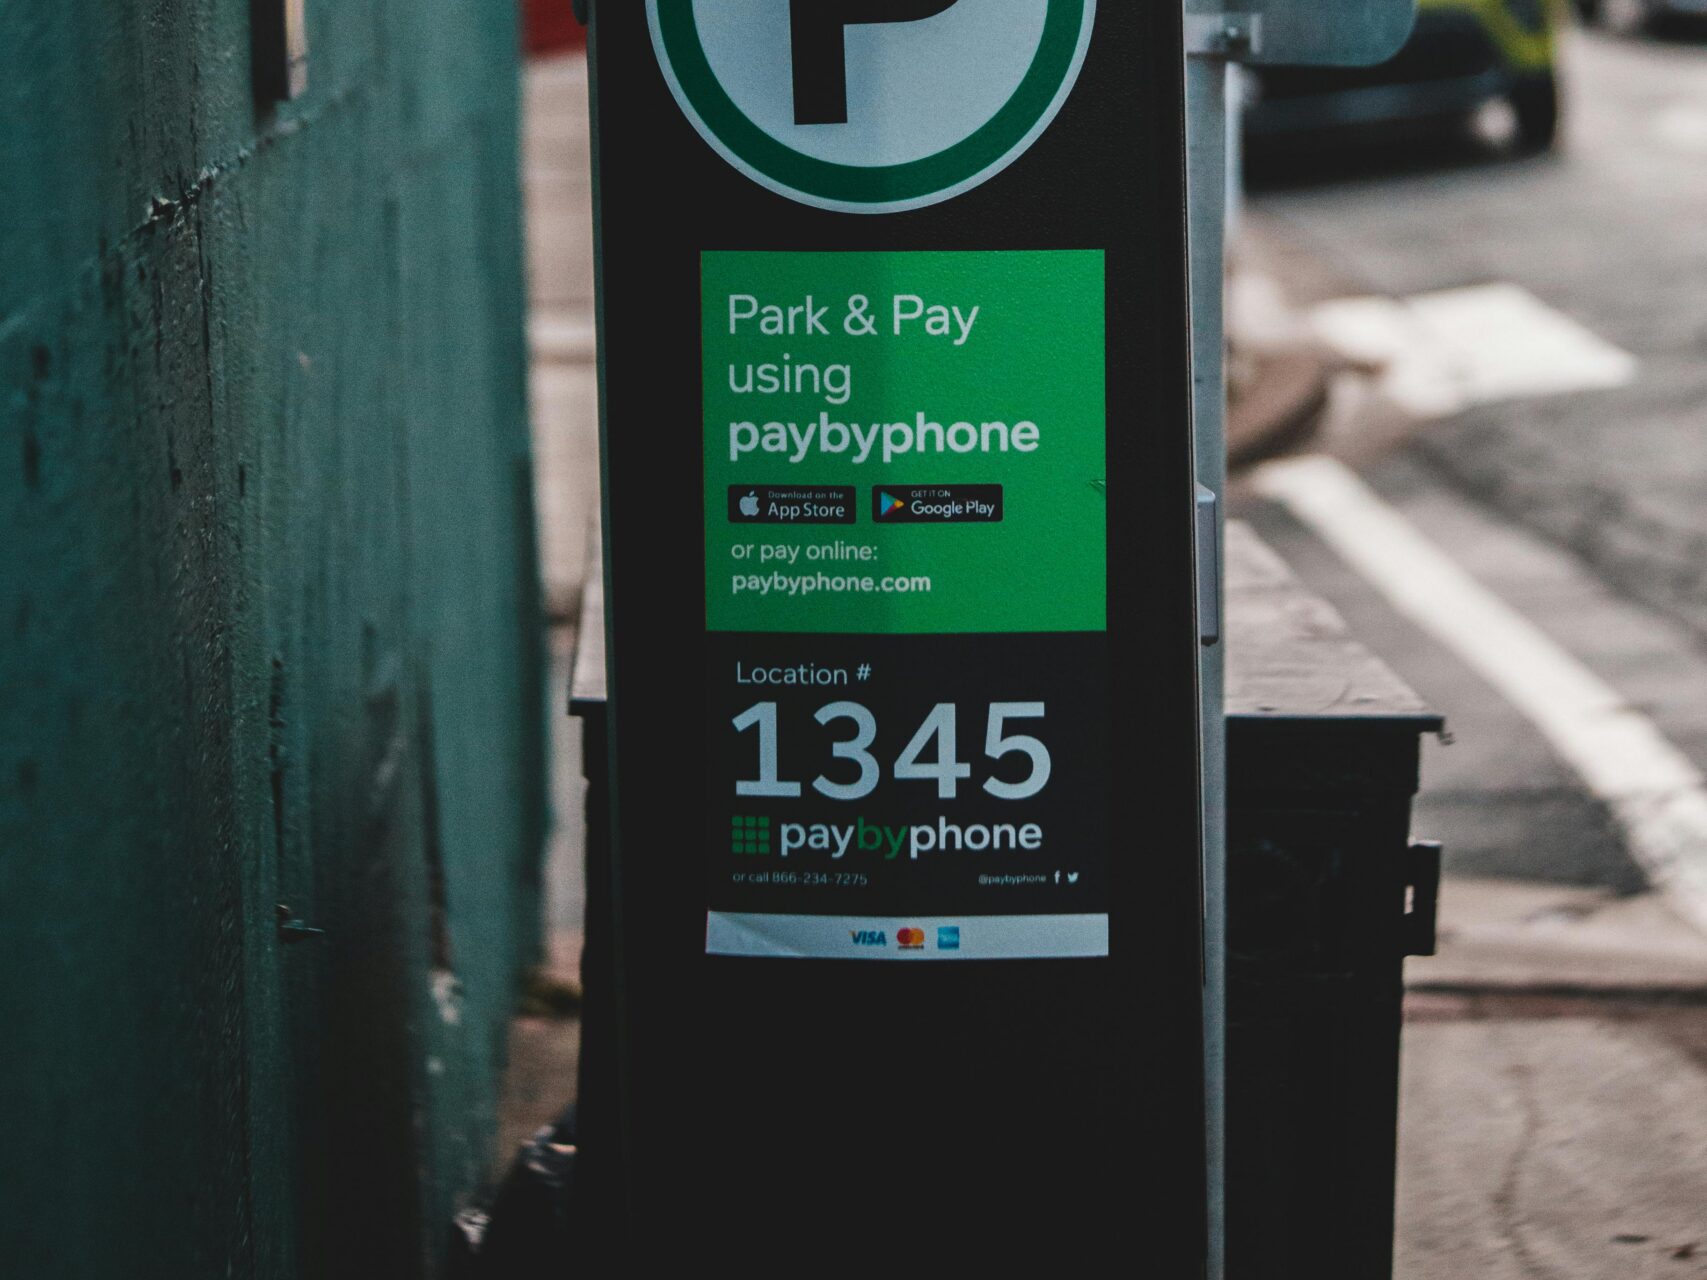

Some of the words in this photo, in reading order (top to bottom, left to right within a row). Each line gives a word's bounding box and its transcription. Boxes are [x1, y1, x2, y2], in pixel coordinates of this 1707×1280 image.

[728, 294, 829, 335] Park
[843, 294, 877, 335] &
[893, 294, 979, 345] Pay
[728, 353, 851, 404] using
[729, 412, 1040, 463] paybyphone
[768, 491, 813, 500] Download
[829, 491, 844, 500] the
[911, 490, 927, 498] GET
[938, 489, 951, 497] ON
[768, 502, 800, 519] App
[803, 502, 845, 517] Store
[911, 500, 963, 518] Google
[966, 501, 995, 517] Play
[731, 544, 754, 559] or
[761, 544, 800, 564] pay
[806, 541, 878, 560] online:
[732, 571, 931, 595] paybyphone.com
[736, 661, 848, 685] Location
[856, 664, 872, 681] #
[732, 701, 1051, 800] 1345
[781, 816, 1042, 859] paybyphone
[732, 873, 745, 882] or
[749, 872, 769, 883] call
[849, 930, 887, 946] VISA
